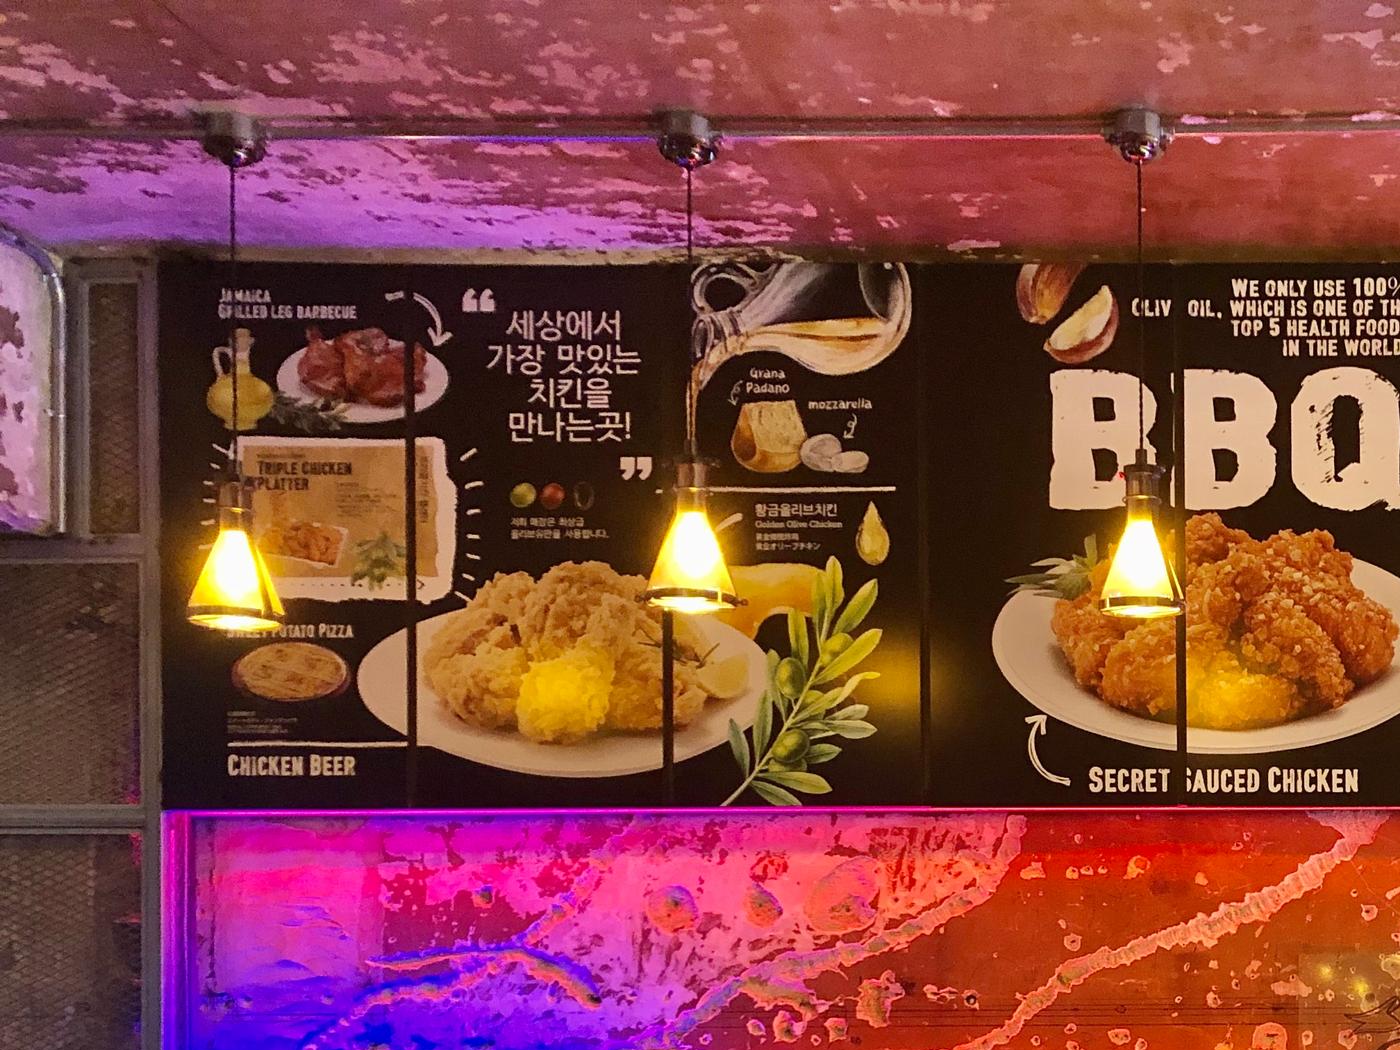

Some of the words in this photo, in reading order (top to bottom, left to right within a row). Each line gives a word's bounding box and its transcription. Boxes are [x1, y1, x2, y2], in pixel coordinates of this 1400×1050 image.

[1231, 278, 1259, 297] WE
[1265, 279, 1307, 297] ONLY
[1313, 279, 1346, 297] USE
[1229, 299, 1285, 317] WHICH
[1290, 299, 1307, 317] IS
[1313, 299, 1347, 317] ONE
[1353, 299, 1374, 317] OF
[506, 310, 621, 341] 세상에서
[1231, 319, 1263, 337] TOP
[1269, 318, 1280, 336] 5
[1286, 319, 1350, 336] HEALTH
[1282, 339, 1300, 357] IN
[1306, 339, 1338, 356] THE
[486, 344, 546, 375] 가장
[557, 344, 642, 375] 맛있는
[750, 368, 786, 379] Grana
[528, 377, 612, 409] 치킨을
[746, 382, 790, 394] Padano
[808, 398, 873, 410] mozzarella
[509, 412, 631, 443] 만나는곳!
[257, 461, 297, 475] TRIPLE
[301, 460, 352, 475] CHICKEN
[755, 503, 838, 518] 황금올리브치킨
[318, 623, 353, 638] PIZZA
[227, 754, 304, 777] CHICKEN
[309, 754, 356, 777] BEER
[1088, 766, 1171, 793] SECRET
[1267, 766, 1359, 793] CHICKEN
